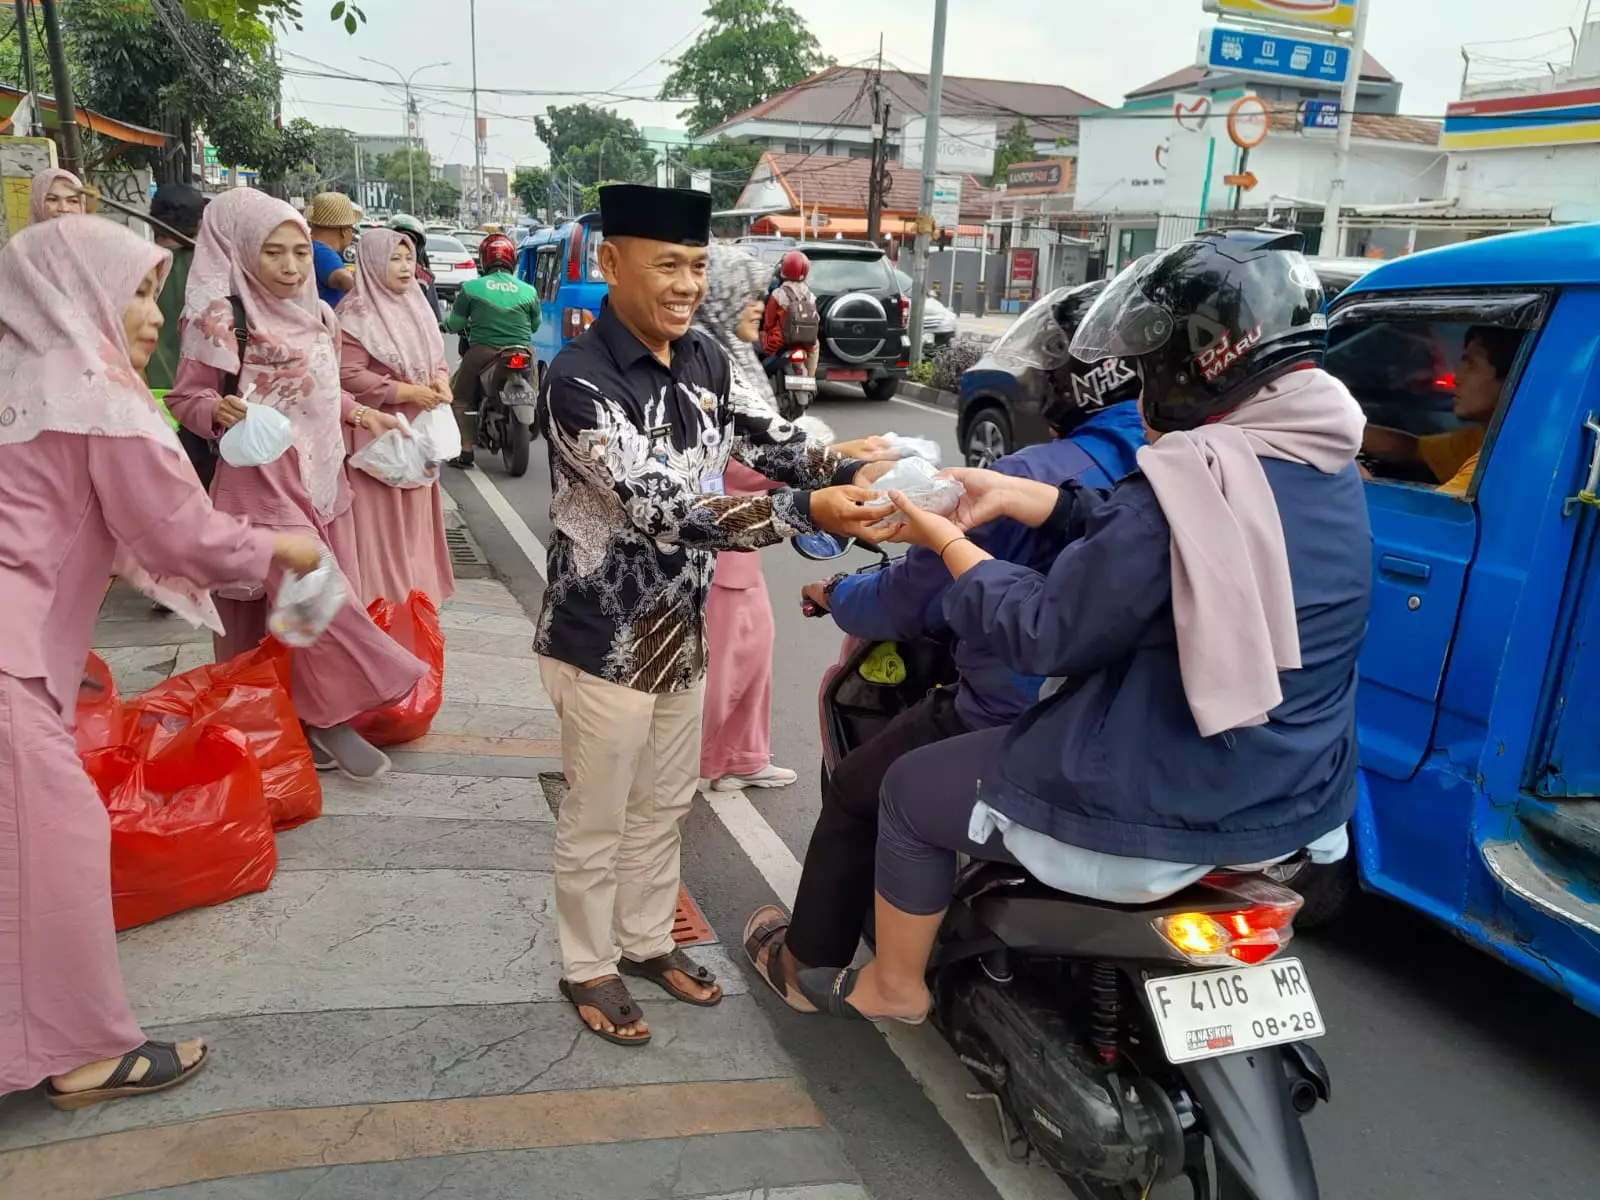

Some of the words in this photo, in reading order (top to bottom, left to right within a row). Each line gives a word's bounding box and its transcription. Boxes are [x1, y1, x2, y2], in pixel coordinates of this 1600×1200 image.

[485, 279, 519, 293] Grab
[1198, 332, 1229, 368] DJ
[1203, 325, 1263, 381] MARU
[1156, 986, 1171, 1018] F
[1190, 975, 1249, 1011] 4106
[1271, 965, 1306, 998] MR
